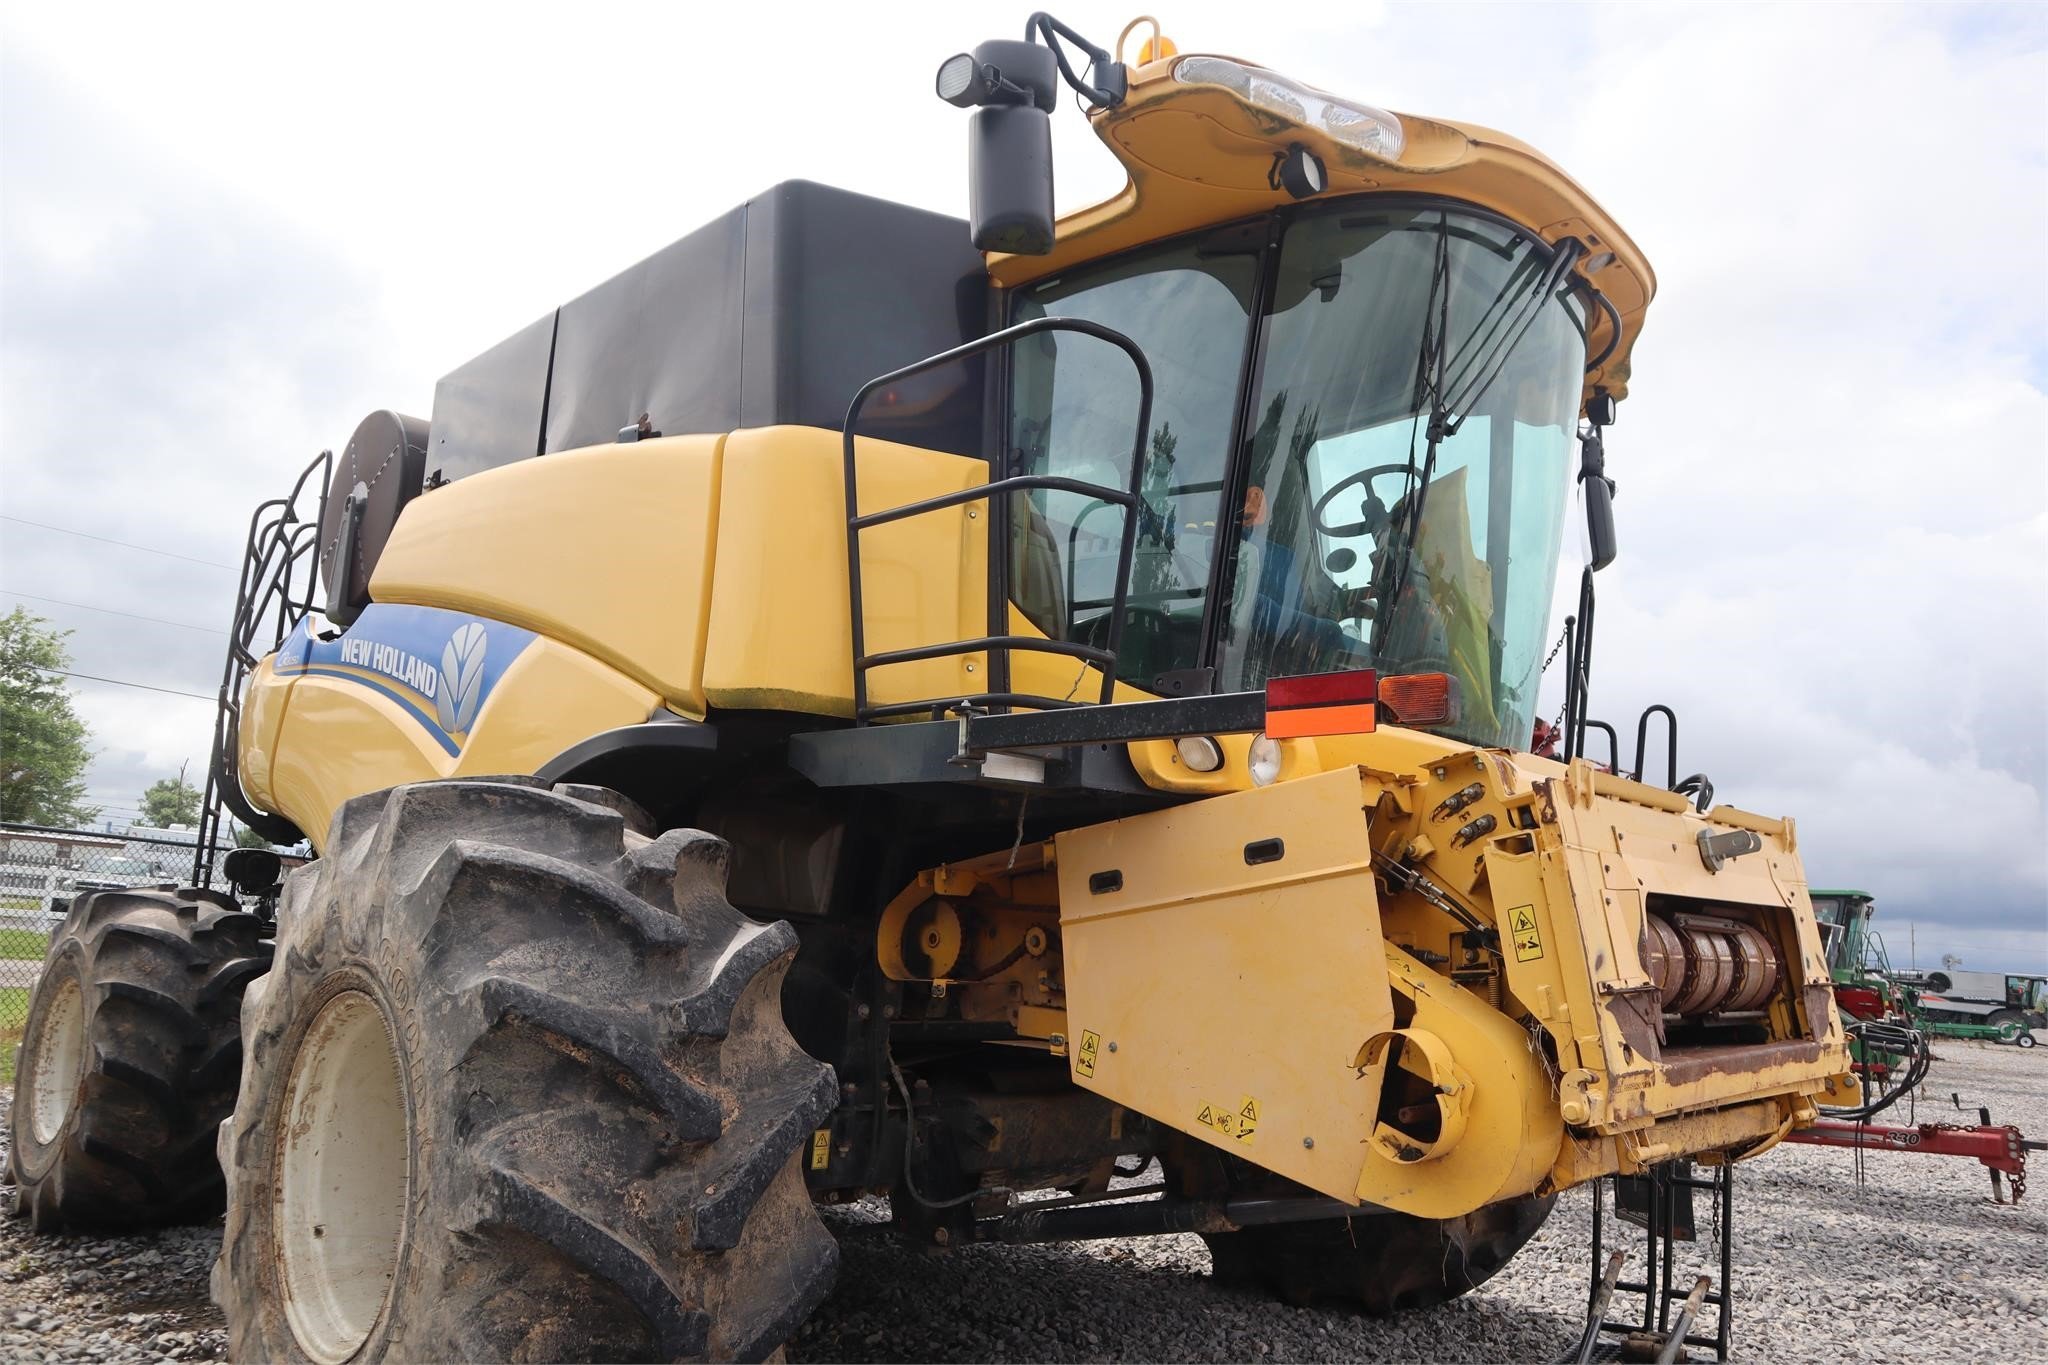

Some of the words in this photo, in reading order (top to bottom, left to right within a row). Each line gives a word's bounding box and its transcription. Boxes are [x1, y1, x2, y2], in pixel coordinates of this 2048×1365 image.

[341, 638, 373, 667] NEW
[372, 642, 437, 699] HOLLAND
[1888, 1131, 1920, 1146] 330
